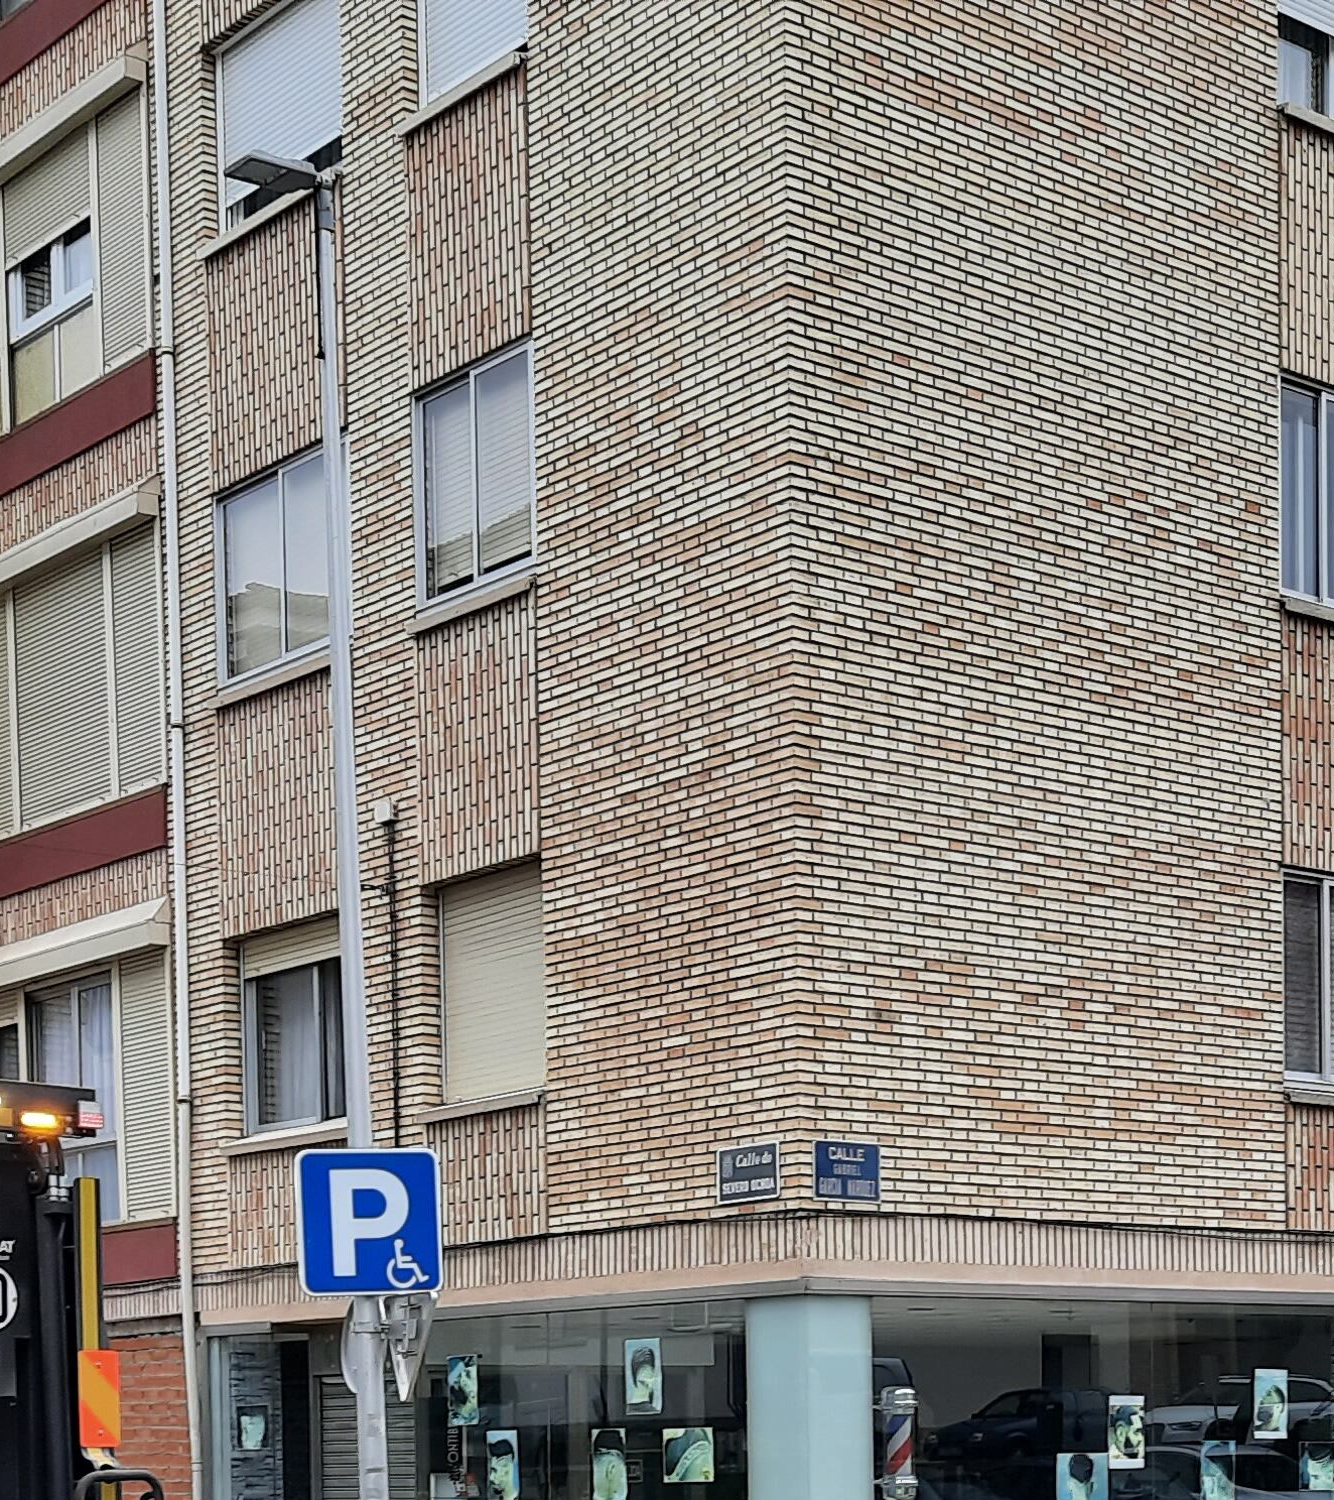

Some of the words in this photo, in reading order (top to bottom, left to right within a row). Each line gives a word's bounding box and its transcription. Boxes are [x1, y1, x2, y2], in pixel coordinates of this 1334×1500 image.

[736, 1152, 761, 1168] Calle
[828, 1146, 866, 1162] CALLE
[329, 1168, 410, 1277] P
